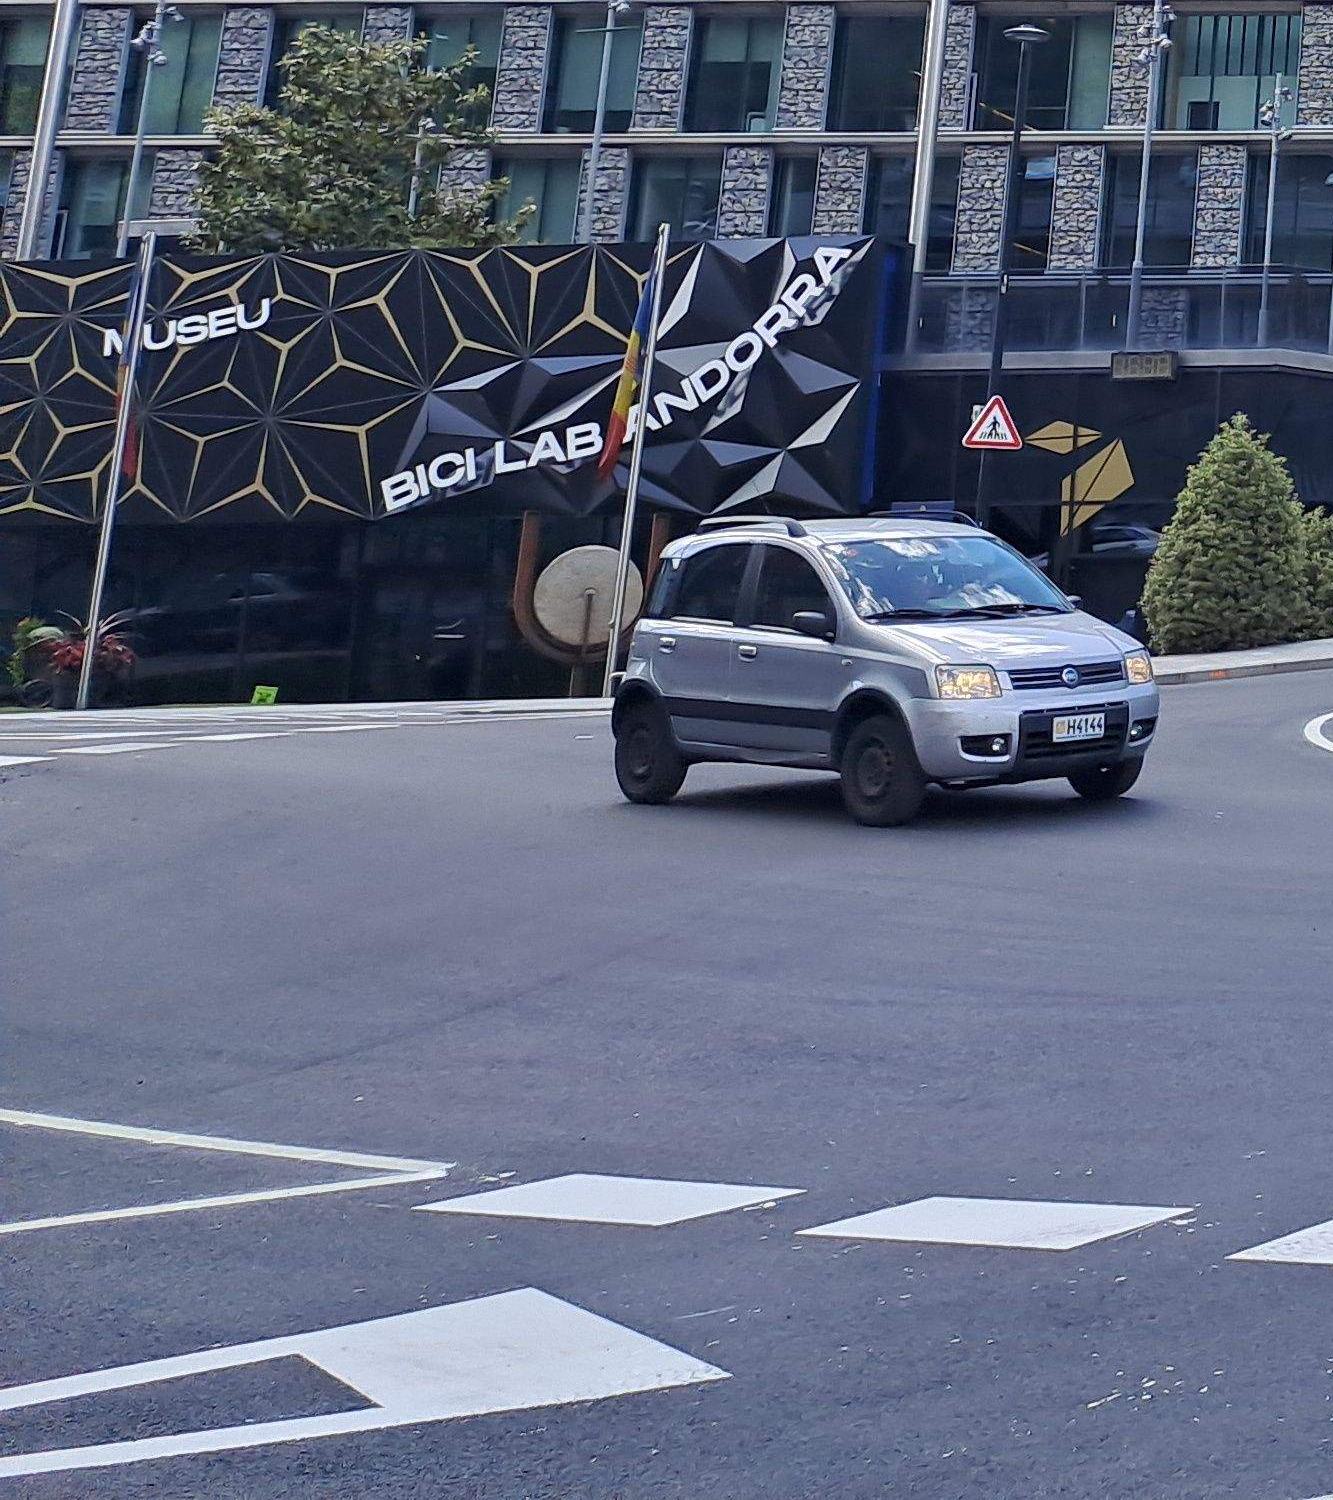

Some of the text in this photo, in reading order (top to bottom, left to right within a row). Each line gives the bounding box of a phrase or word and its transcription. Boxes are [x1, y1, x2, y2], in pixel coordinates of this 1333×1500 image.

[379, 246, 853, 512] BICI LAB ANDORRA
[1066, 716, 1103, 735] H4144
